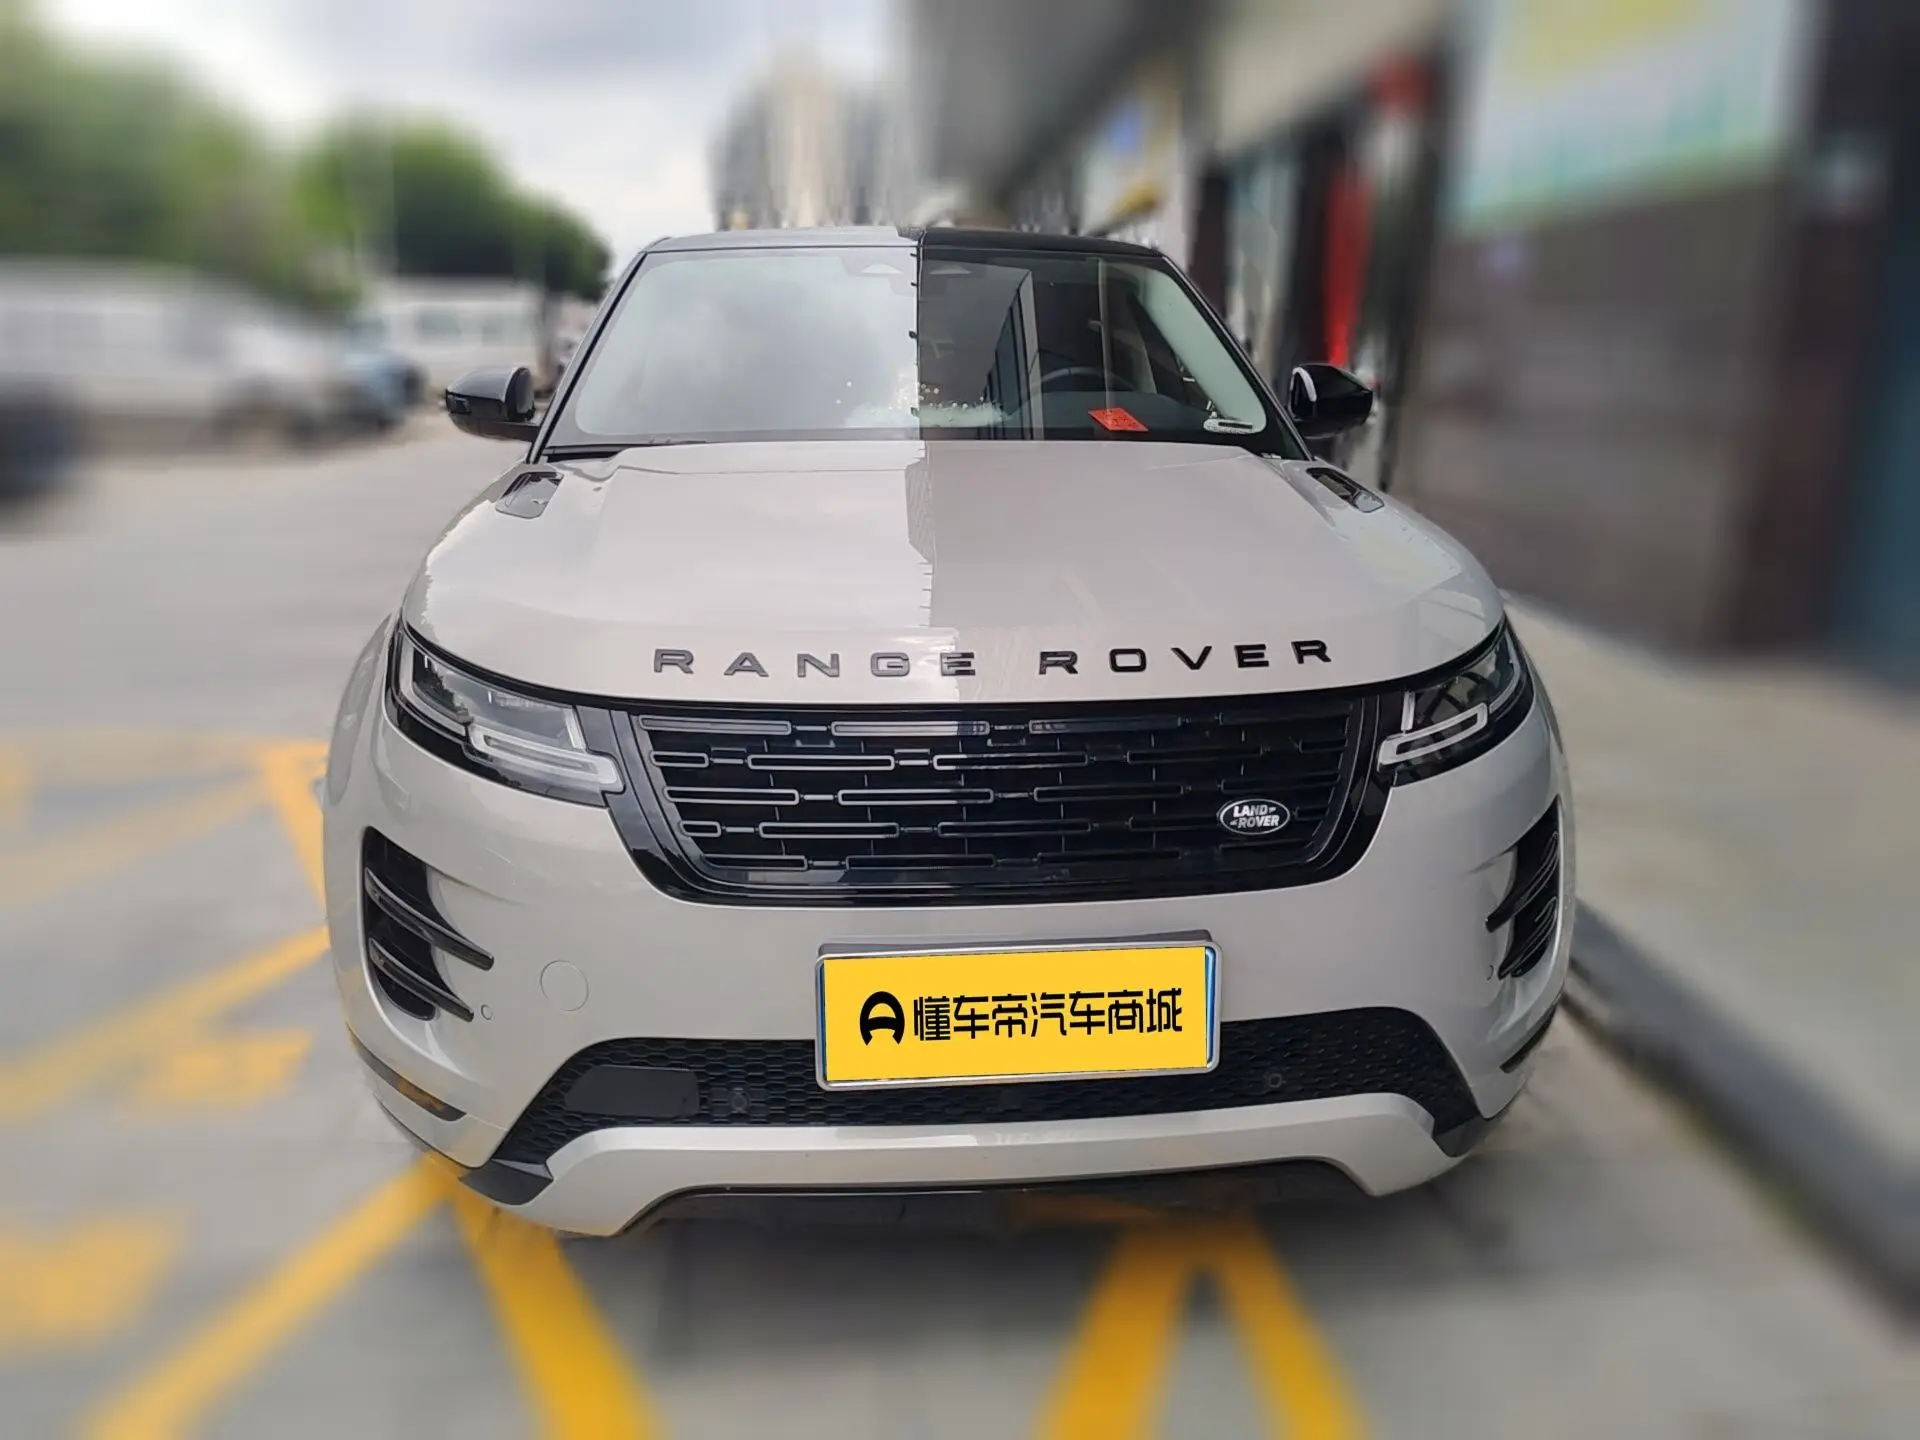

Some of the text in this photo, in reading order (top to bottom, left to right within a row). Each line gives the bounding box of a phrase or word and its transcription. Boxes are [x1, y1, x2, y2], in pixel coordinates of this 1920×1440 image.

[653, 639, 1332, 678] RANGE ROVER
[1233, 804, 1268, 817] LAND
[1238, 814, 1280, 828] ROVER
